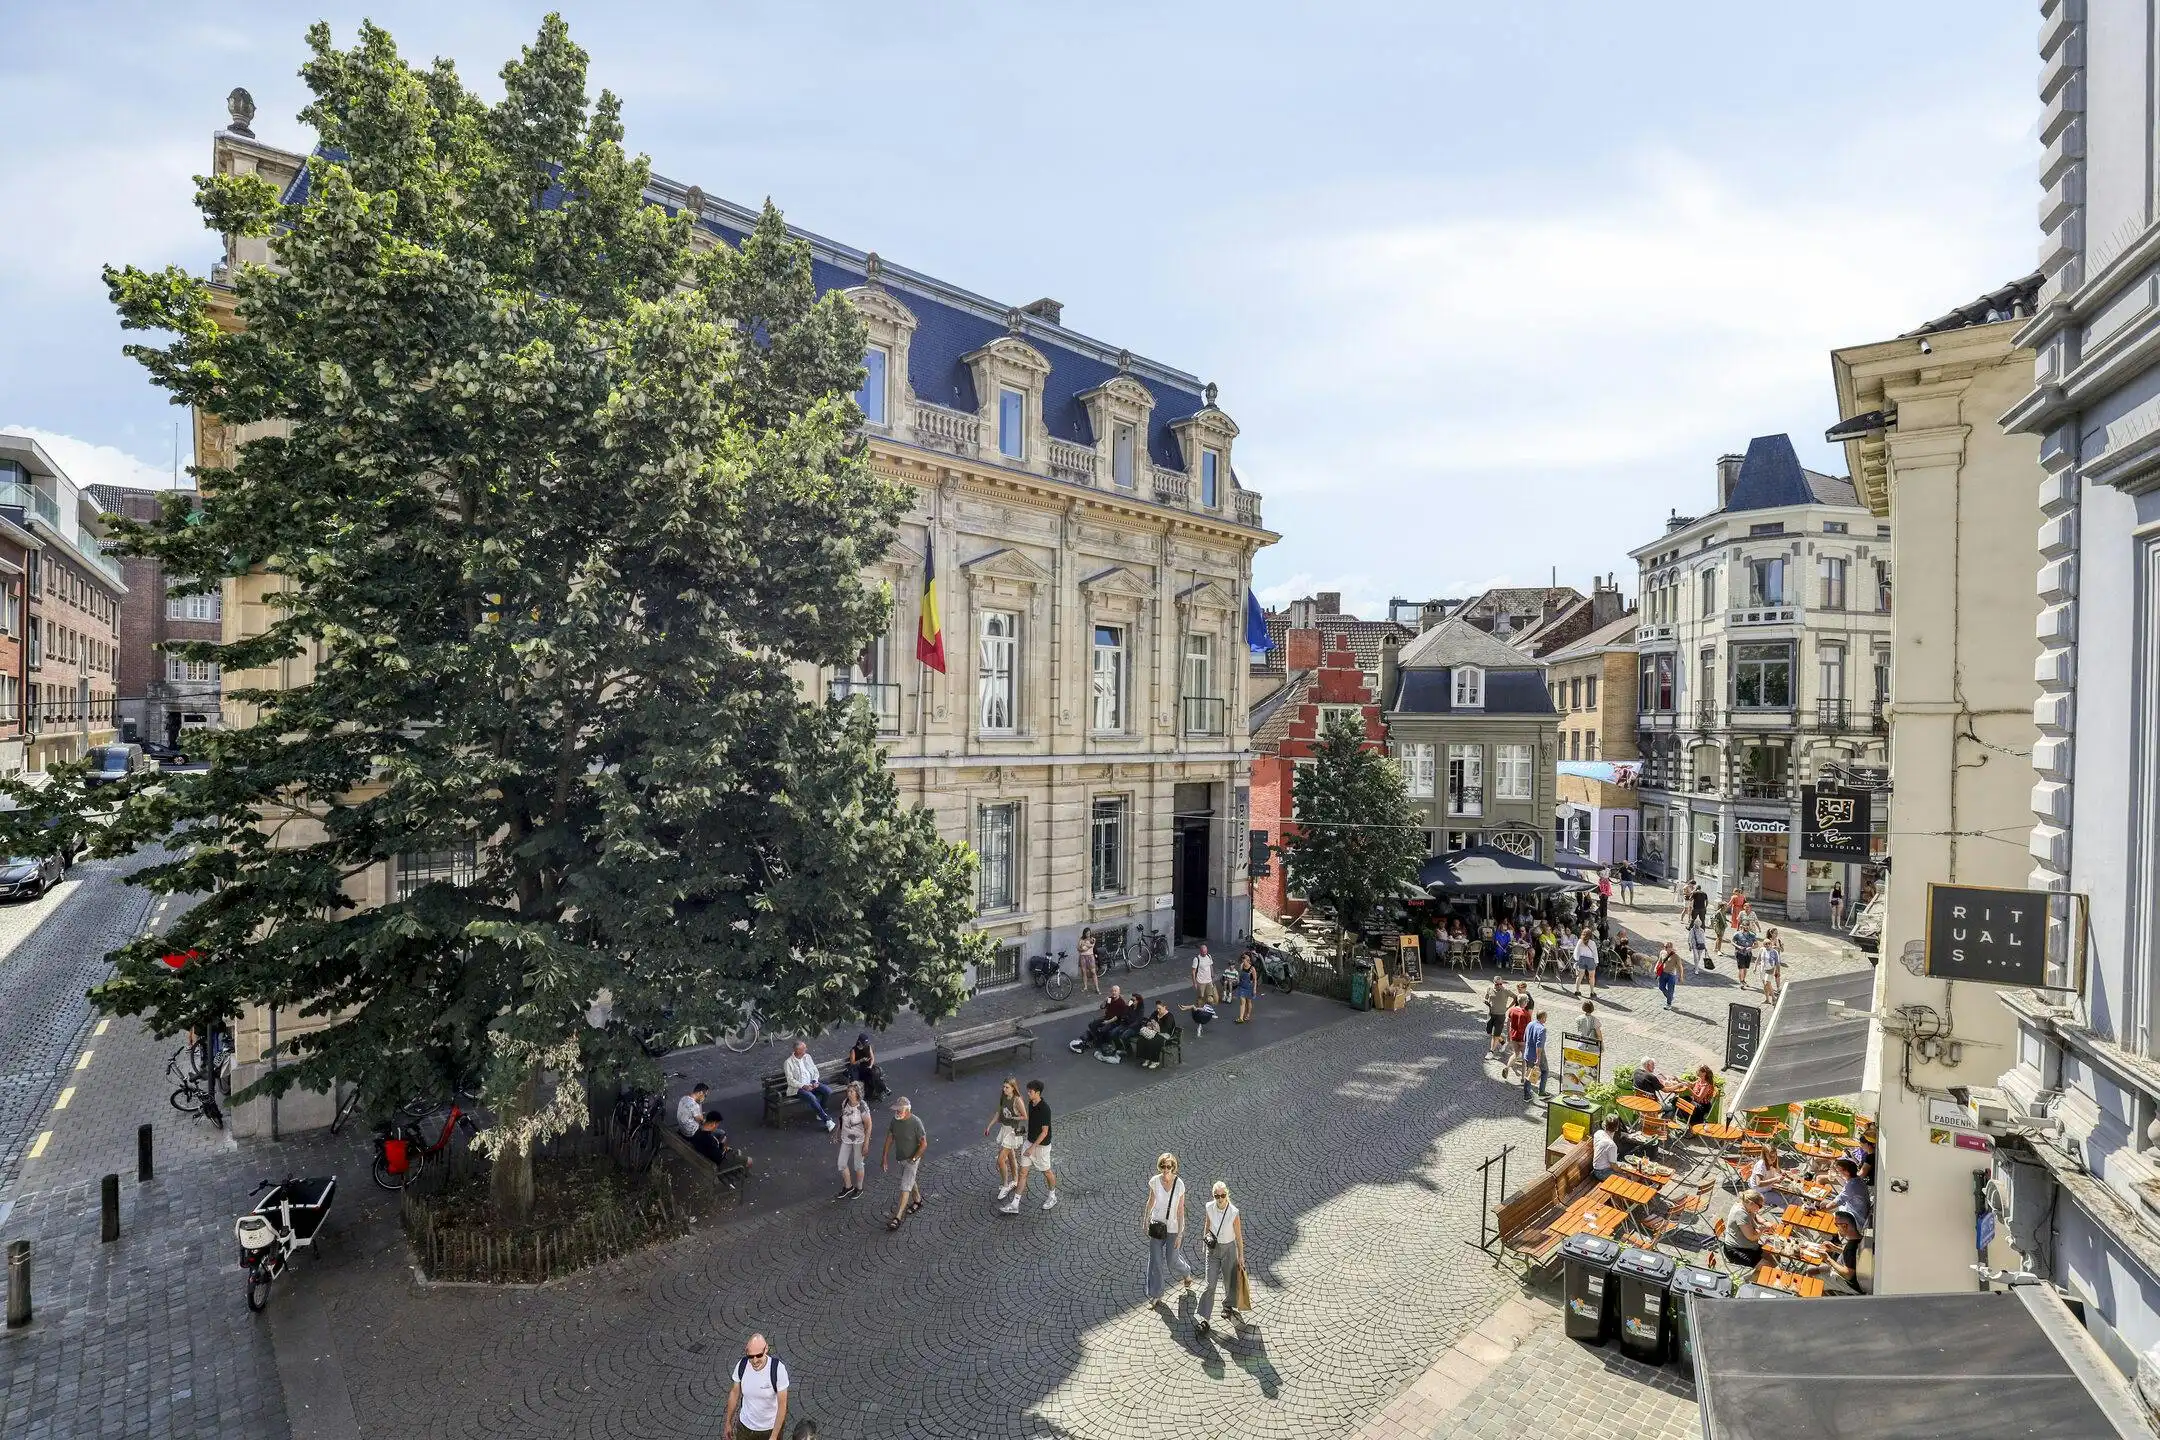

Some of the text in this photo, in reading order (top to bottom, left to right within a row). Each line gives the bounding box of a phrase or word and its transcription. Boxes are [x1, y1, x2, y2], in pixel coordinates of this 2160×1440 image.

[1740, 820, 1784, 832] Wondr
[1809, 843, 1861, 851] QUOTIDIEN
[1736, 1022, 1751, 1061] SALE
